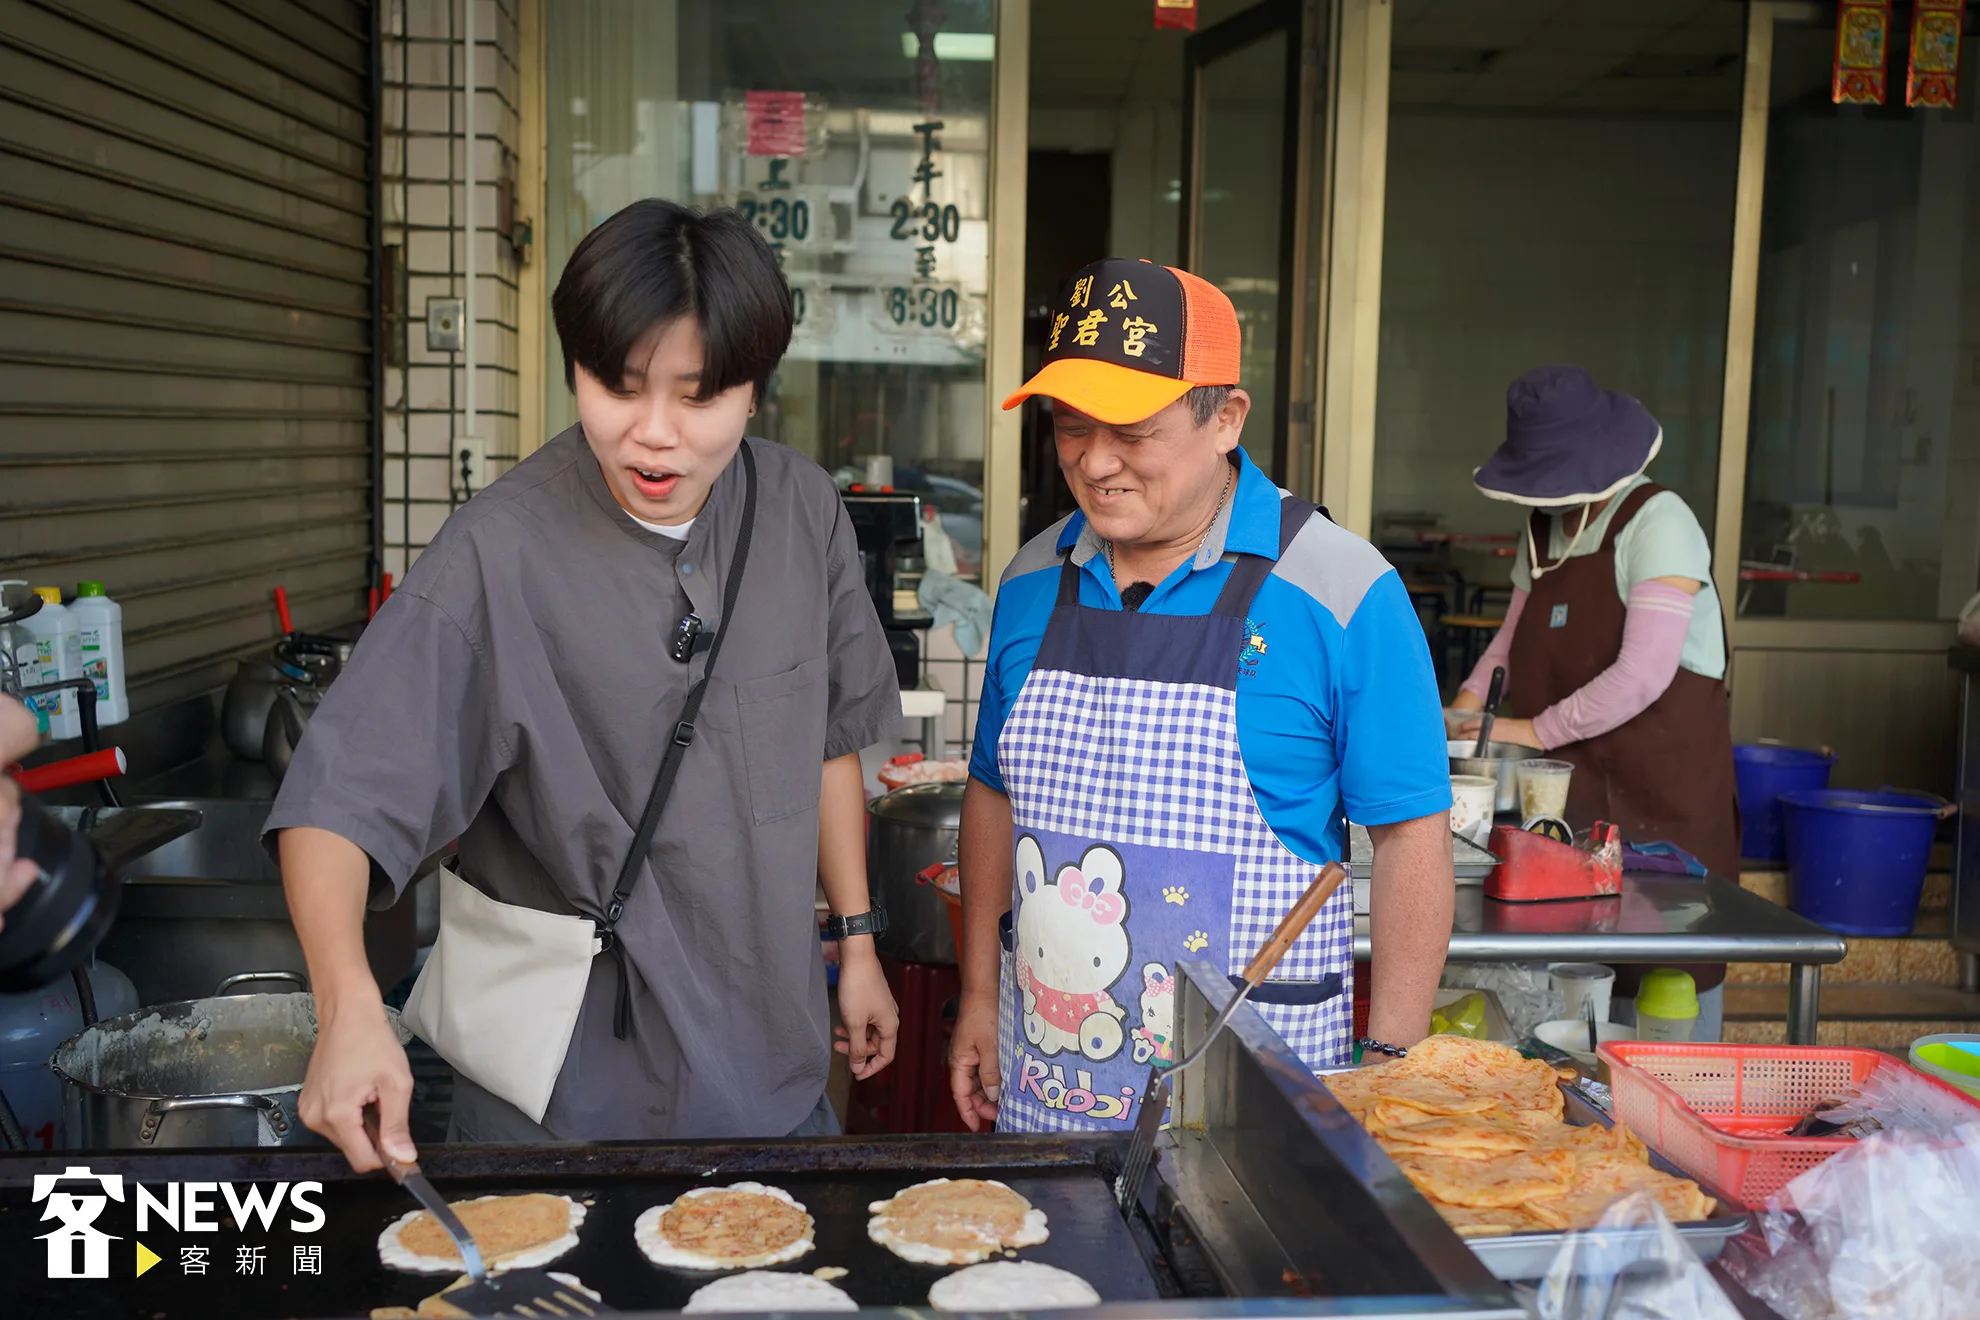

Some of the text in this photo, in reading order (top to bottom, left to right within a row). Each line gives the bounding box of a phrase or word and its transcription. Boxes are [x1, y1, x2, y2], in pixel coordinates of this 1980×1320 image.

[912, 121, 944, 198] 下午
[890, 200, 959, 242] 2:30
[1069, 275, 1138, 310] 劉公
[1047, 308, 1158, 357] 聖君宮
[1018, 1053, 1171, 1121] Rabbi
